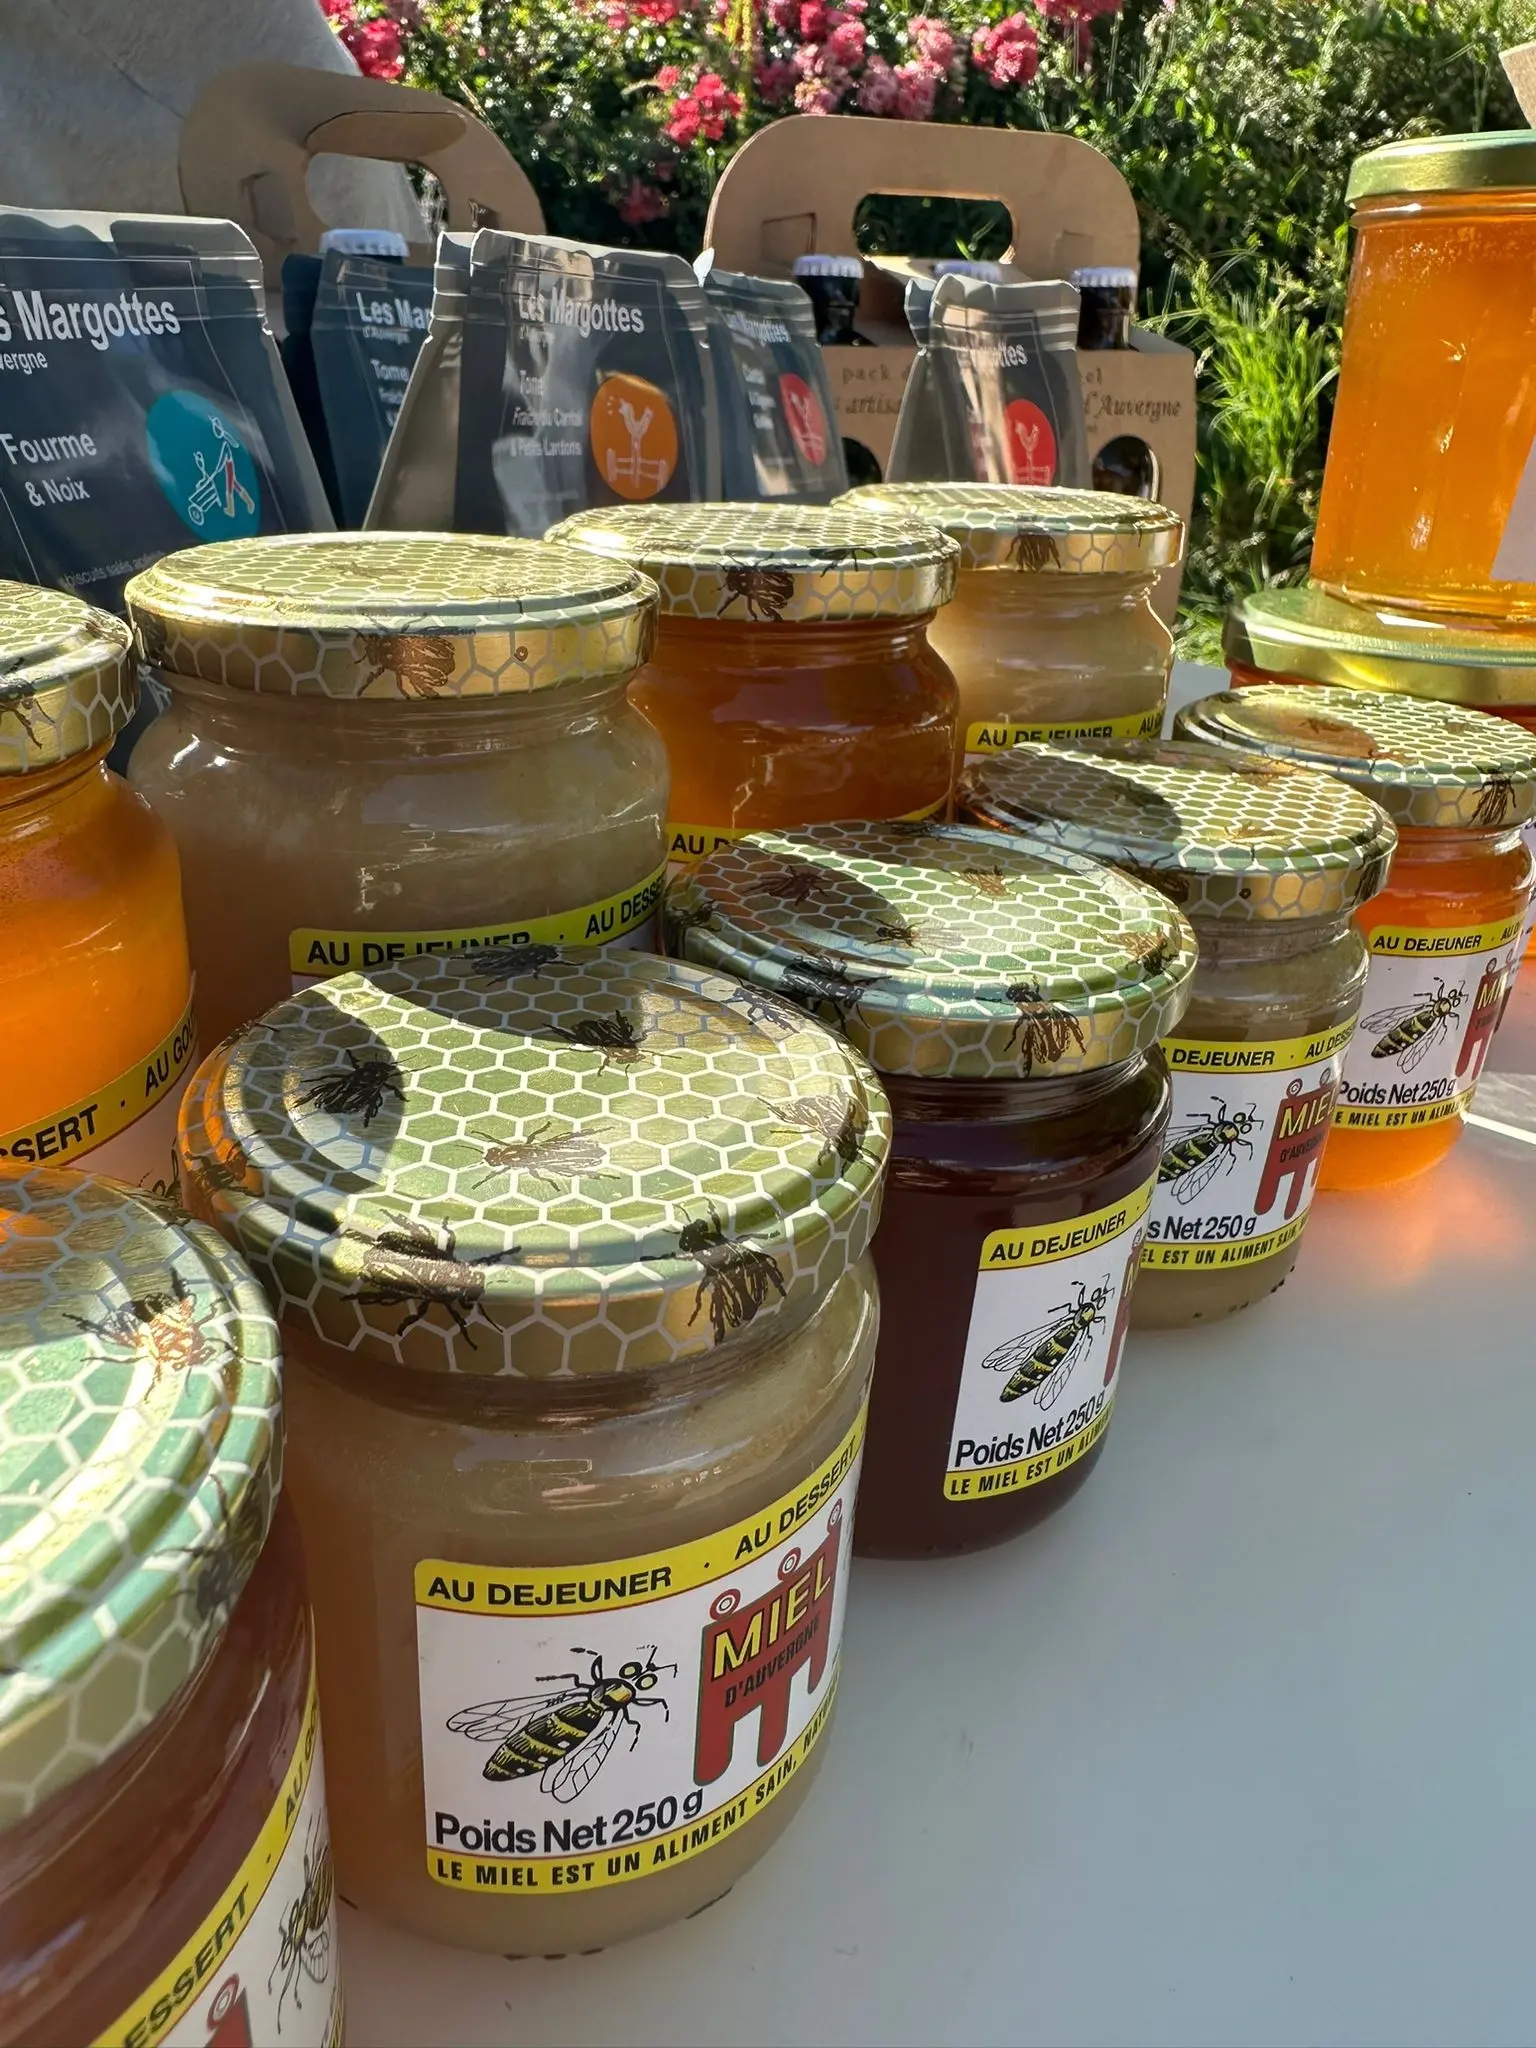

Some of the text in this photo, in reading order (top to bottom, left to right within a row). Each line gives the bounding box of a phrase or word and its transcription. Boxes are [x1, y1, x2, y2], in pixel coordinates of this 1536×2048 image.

[12, 290, 181, 351] Margottes
[356, 292, 396, 325] Les
[518, 281, 545, 322] Les
[549, 283, 645, 338] Margottes
[843, 364, 890, 385] pack
[0, 433, 97, 465] Fourme
[25, 476, 90, 507] & Noix
[977, 728, 1008, 746] AU
[672, 833, 704, 855] AU
[308, 940, 350, 966] AU
[585, 906, 615, 939] AU
[1373, 935, 1399, 949] AU
[1404, 934, 1482, 951] DEJEUNER
[145, 1051, 170, 1097] AU
[1172, 1049, 1275, 1067] DEJEUNER
[1305, 1040, 1326, 1059] AU
[1278, 1086, 1336, 1141] MIEL
[1387, 1083, 1419, 1105] Net
[1348, 1113, 1380, 1127] MIEL
[1385, 1111, 1403, 1126] EST
[1411, 1110, 1425, 1123] UN
[989, 1210, 1126, 1263] AU DEJEUNER
[1163, 1215, 1202, 1240] Net
[1162, 1248, 1188, 1264] EST
[1195, 1248, 1216, 1264] UN
[1221, 1237, 1273, 1263] ALIMENT
[955, 1433, 1024, 1468] Poids
[1027, 1416, 1064, 1451] Net
[950, 1477, 970, 1496] LE
[978, 1470, 1018, 1493] MIEL
[1026, 1456, 1051, 1480] EST
[1057, 1444, 1075, 1467] UN
[428, 1435, 856, 1605] AU DEJEUNER AU DESSERT
[711, 1552, 832, 1682] MIEL
[725, 1612, 820, 1708] D'AUVERGNE
[435, 1811, 537, 1854] Poids
[543, 1816, 607, 1853] Net
[437, 1858, 463, 1880] LE
[476, 1865, 538, 1886] MIEL
[552, 1862, 595, 1885] EST
[607, 1851, 640, 1876] UN
[653, 1797, 748, 1865] ALIMENT
[755, 1755, 797, 1805] SAIN,
